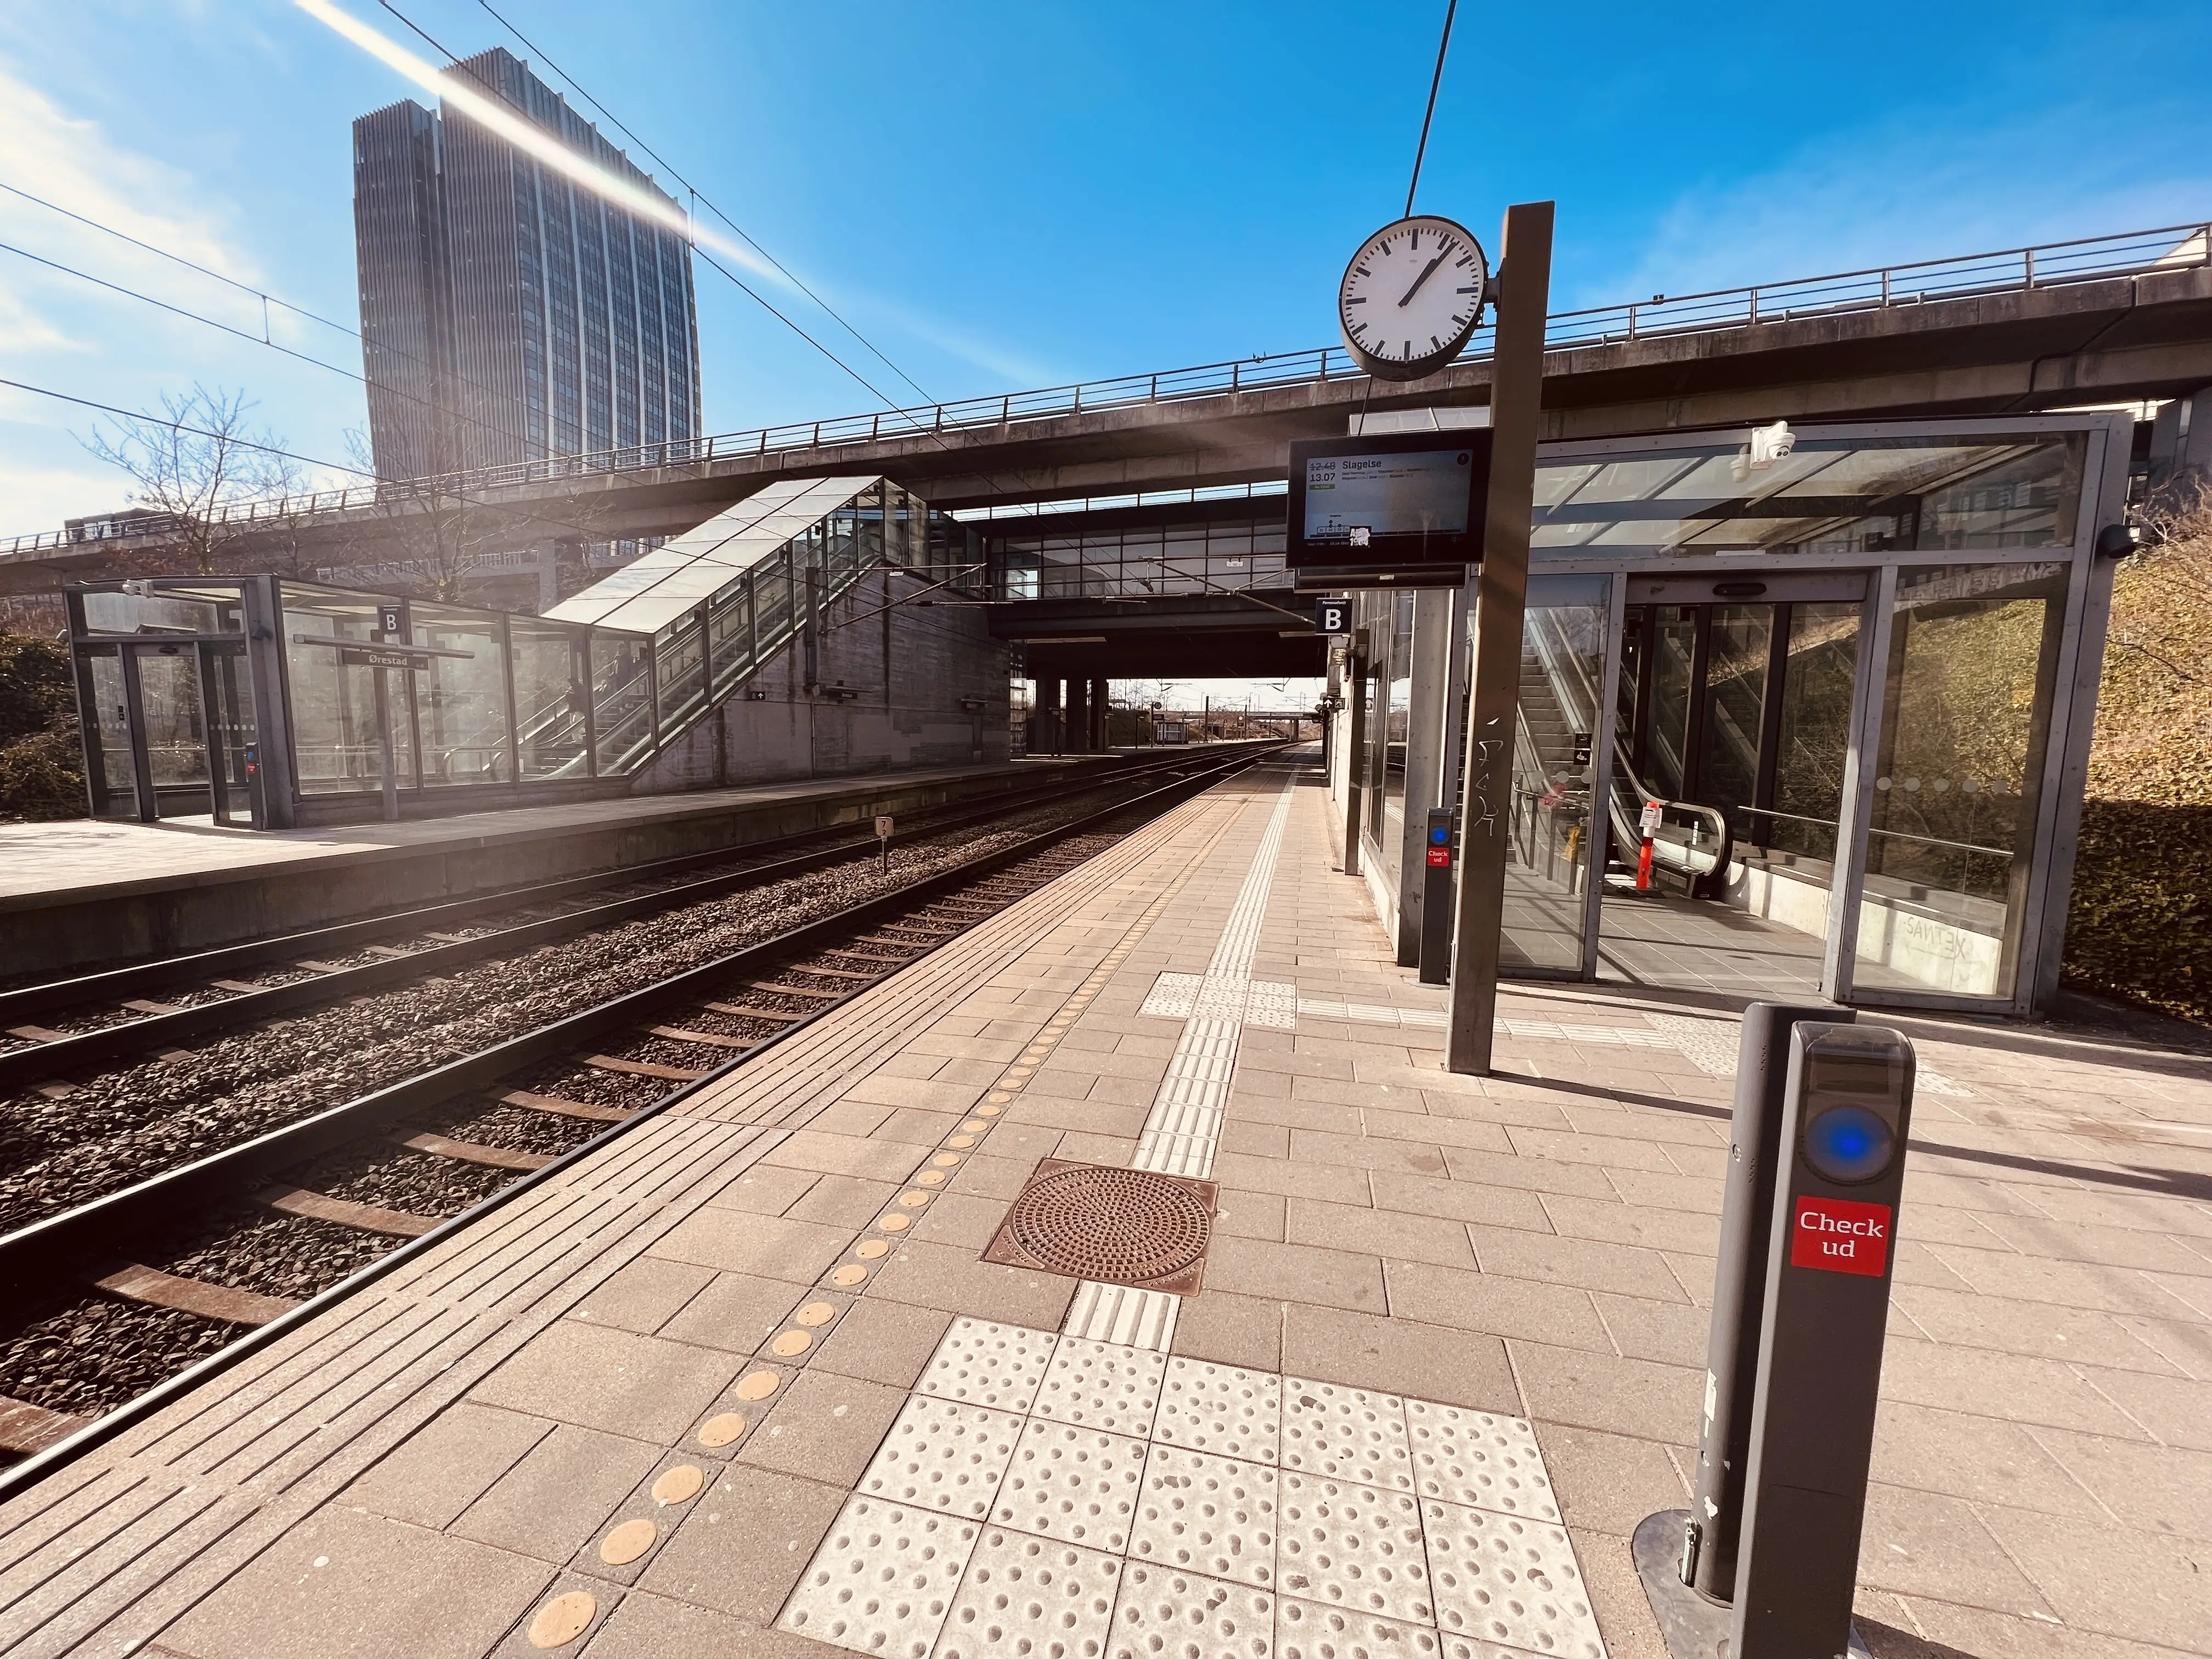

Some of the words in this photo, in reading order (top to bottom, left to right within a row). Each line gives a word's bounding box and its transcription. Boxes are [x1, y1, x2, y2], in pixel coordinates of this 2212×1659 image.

[1310, 462, 1336, 471] 12.48
[1342, 460, 1382, 470] Slagelse
[1310, 473, 1335, 482] 13.07
[386, 614, 397, 630] B
[1325, 609, 1341, 629] B
[369, 654, 408, 665] Ørestad
[1800, 1211, 1883, 1238] Check
[1822, 1240, 1855, 1257] ud
